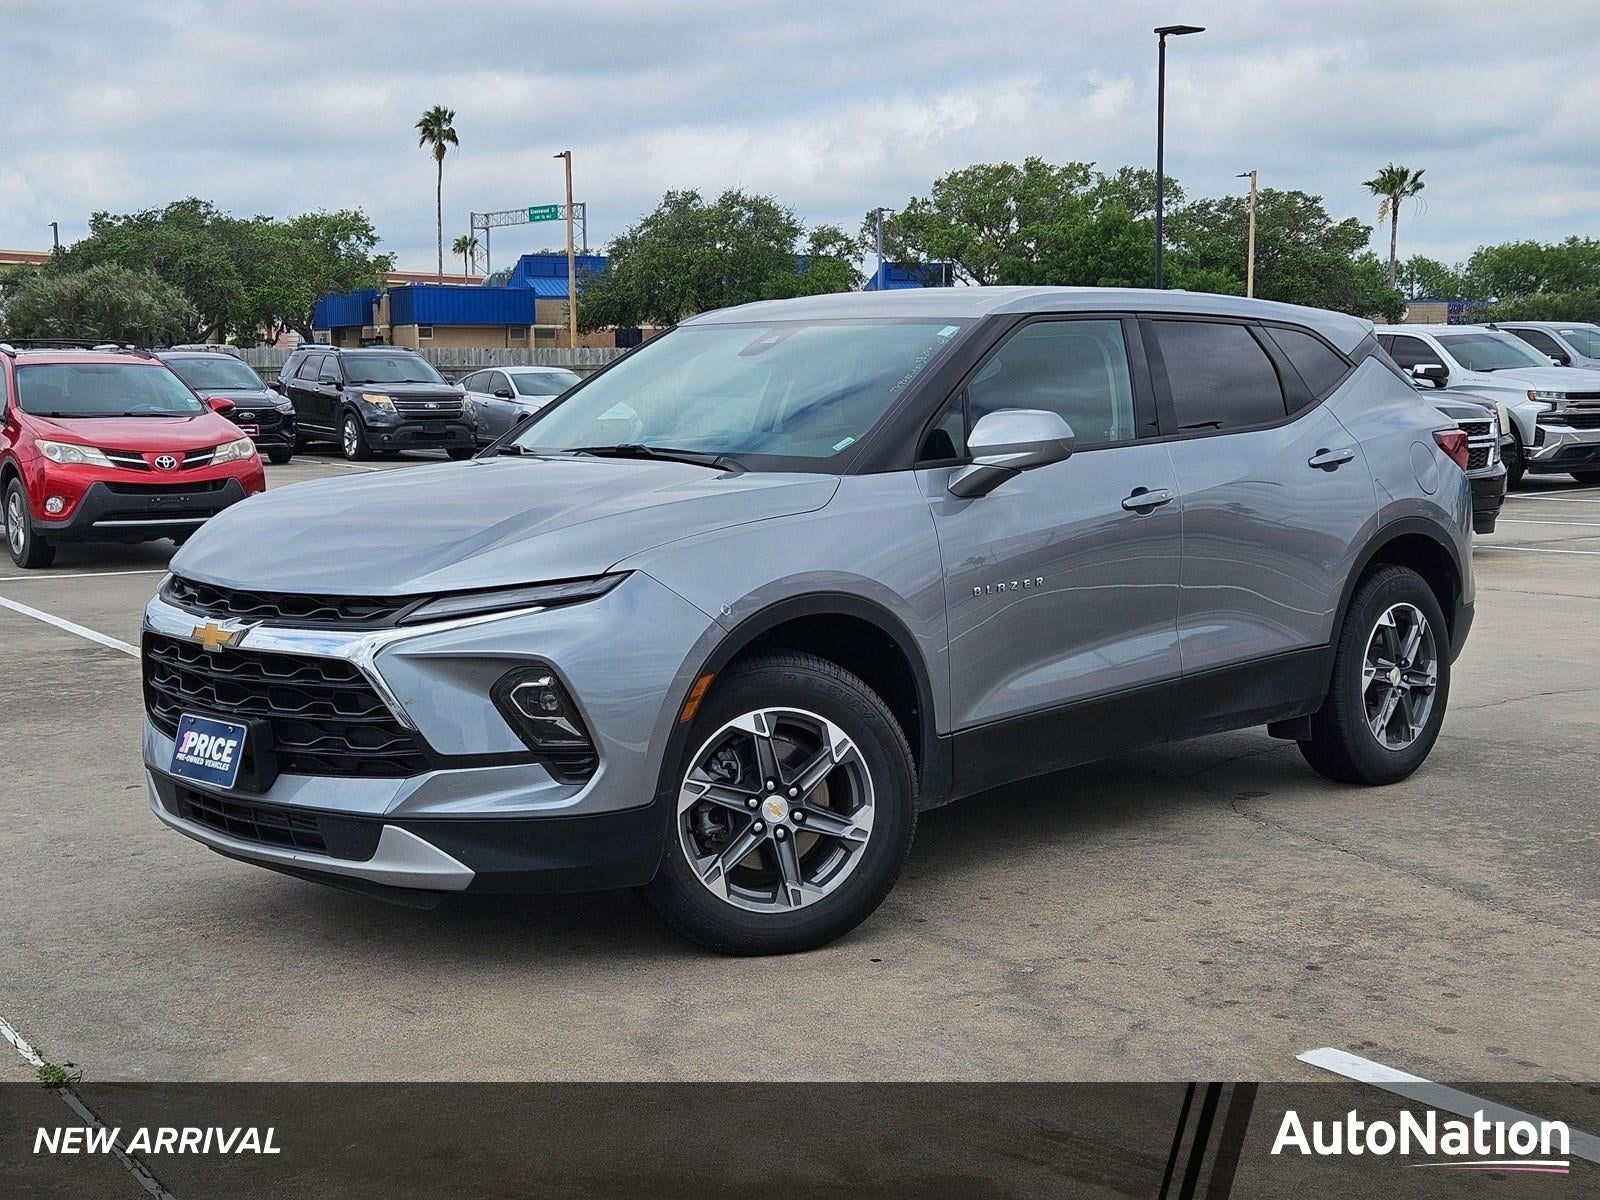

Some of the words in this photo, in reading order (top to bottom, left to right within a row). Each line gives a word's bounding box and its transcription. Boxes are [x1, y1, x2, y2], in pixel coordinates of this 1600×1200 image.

[973, 577, 1044, 597] BLAZER
[176, 753, 204, 765] PRE-OWNED
[204, 759, 230, 771] VEHICLES
